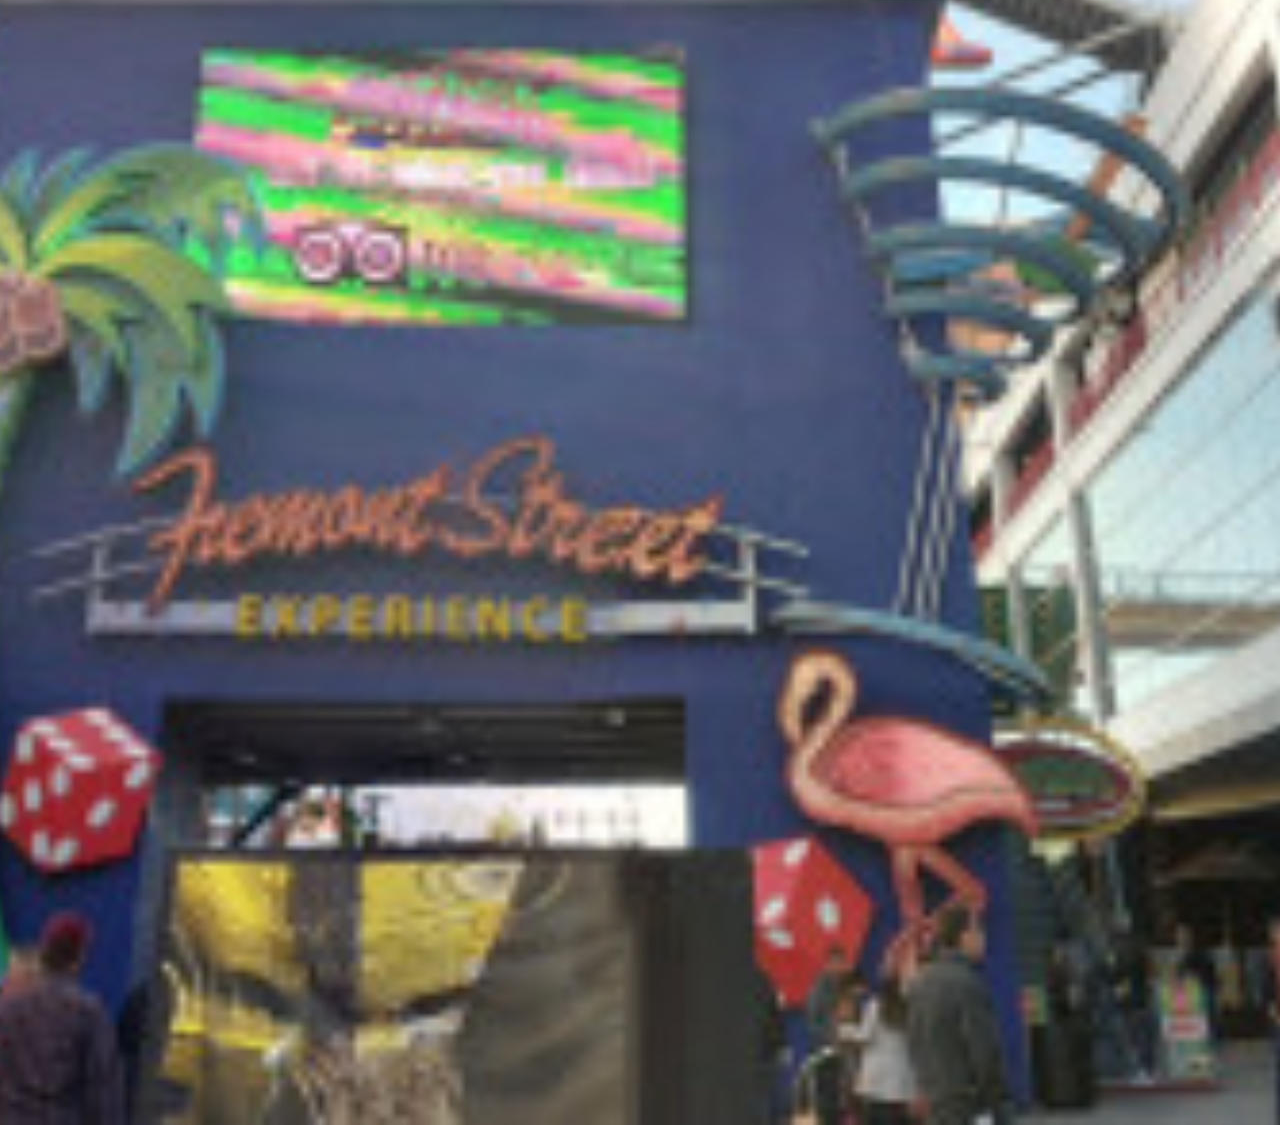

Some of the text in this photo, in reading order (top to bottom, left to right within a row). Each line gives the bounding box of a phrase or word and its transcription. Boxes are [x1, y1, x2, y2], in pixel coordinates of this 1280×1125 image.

[130, 433, 727, 618] Fremont Street
[233, 593, 590, 644] EXPERIENCE
